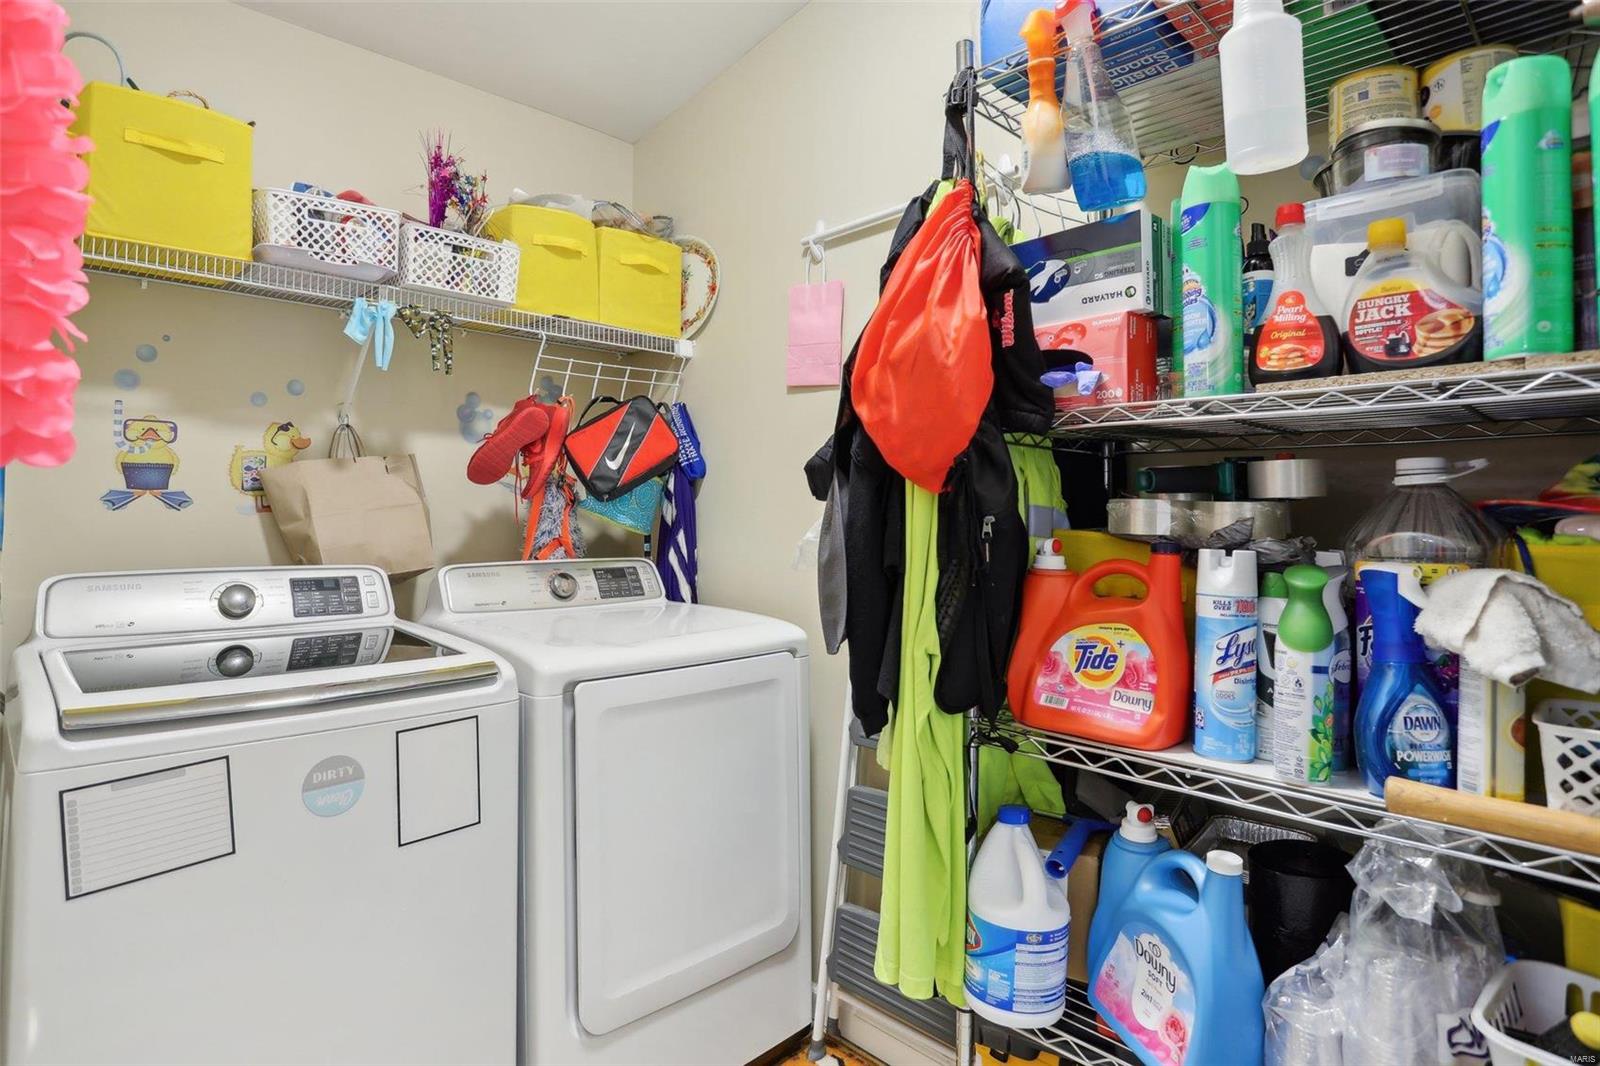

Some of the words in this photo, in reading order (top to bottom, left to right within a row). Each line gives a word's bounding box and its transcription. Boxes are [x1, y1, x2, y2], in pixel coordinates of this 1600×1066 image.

[1111, 60, 1179, 87] Plastic
[1081, 290, 1123, 305] HALYARD
[1357, 294, 1410, 309] HUNGRY
[1277, 304, 1304, 315] Pearl
[1355, 303, 1414, 323] JACK
[1001, 288, 1015, 348] Wilson
[1274, 313, 1307, 322] Milling
[1270, 330, 1307, 340] Original
[1096, 389, 1115, 399] 200
[467, 571, 501, 579] SAMSUNG
[87, 583, 142, 592] SAMSUNG
[1074, 644, 1119, 674] Tide
[1113, 690, 1152, 712] Downy
[1403, 716, 1441, 731] DAWN
[312, 766, 353, 784] DIRTY
[1135, 938, 1177, 994] Downy
